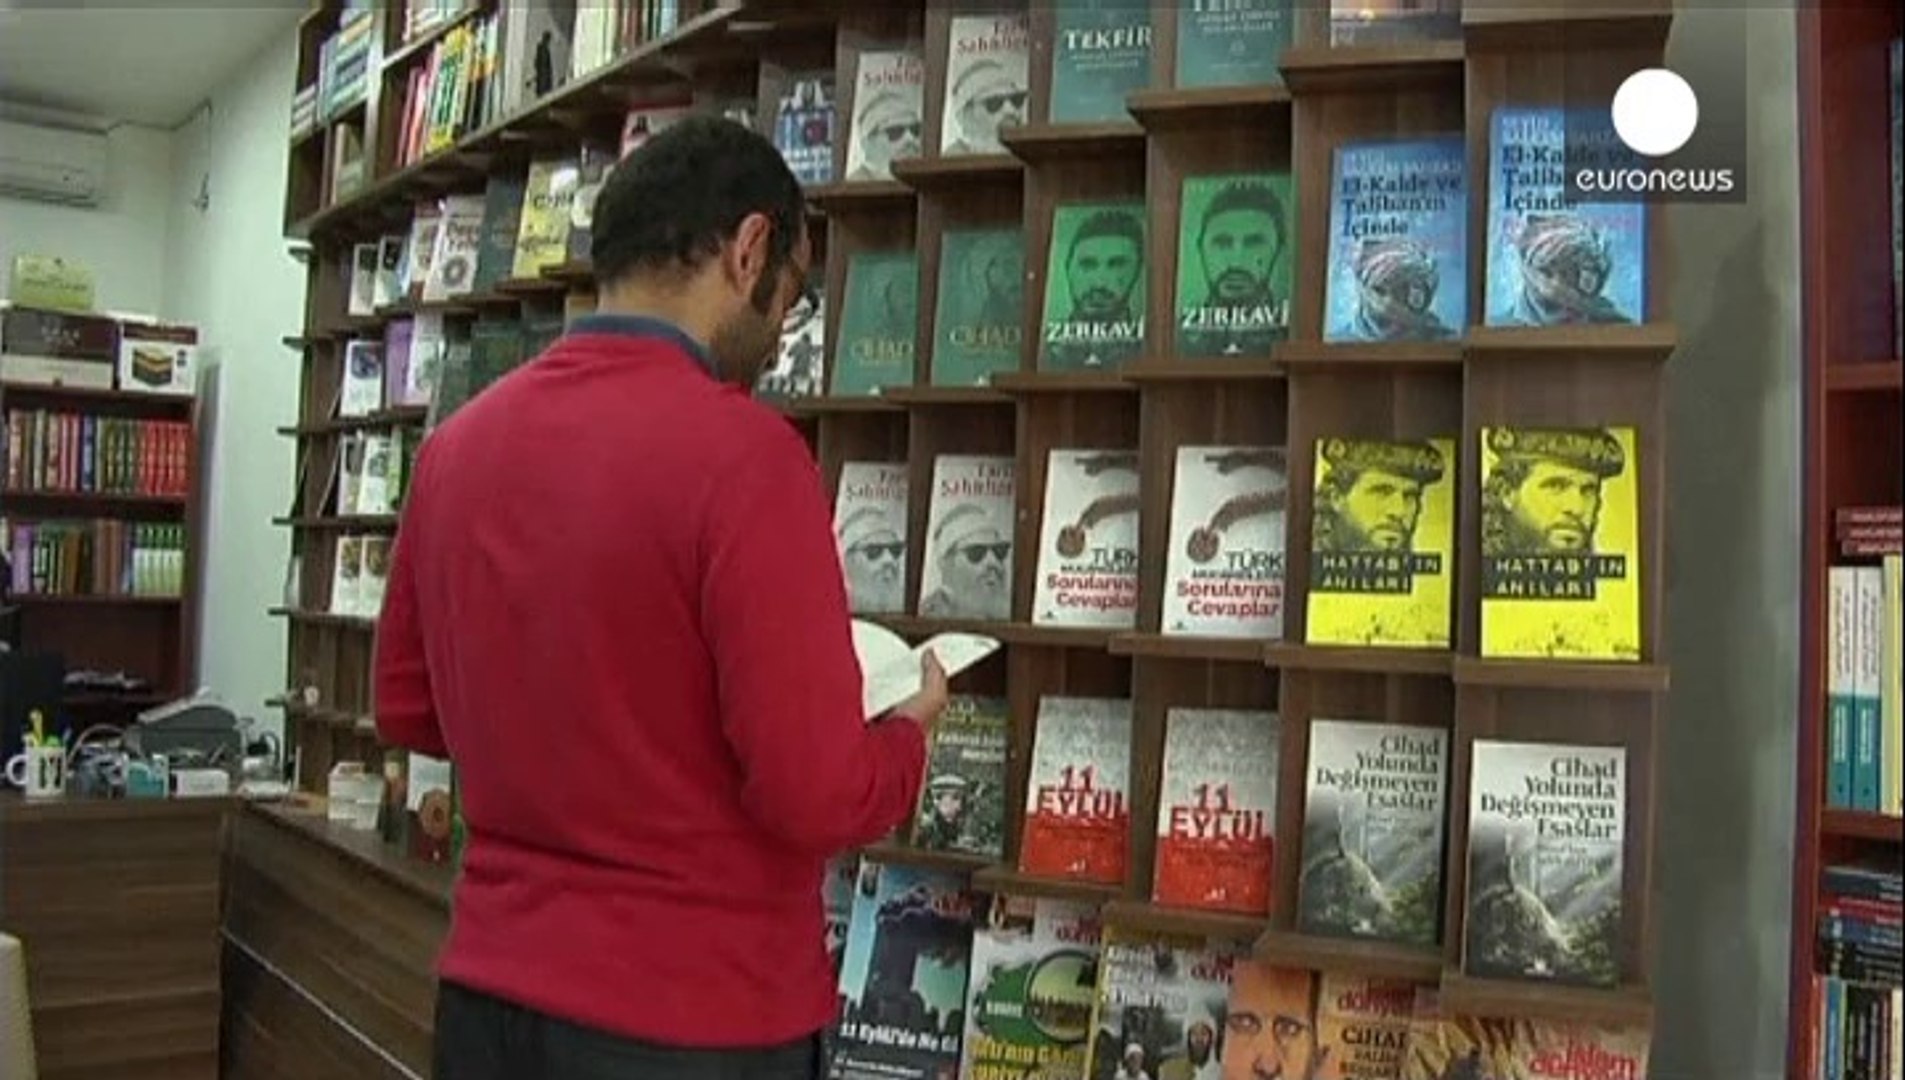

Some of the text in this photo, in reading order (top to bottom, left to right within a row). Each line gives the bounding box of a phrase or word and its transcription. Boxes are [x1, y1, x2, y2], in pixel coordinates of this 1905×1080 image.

[1225, 550, 1283, 570] TÜRK
[1186, 600, 1279, 620] Cevaplar
[1380, 734, 1440, 757] Cihad
[1355, 750, 1438, 775] Yolunda
[1551, 756, 1617, 778] Cihad
[1060, 764, 1095, 791] 11
[1525, 775, 1616, 798] Yolunda
[1194, 782, 1230, 811] 11
